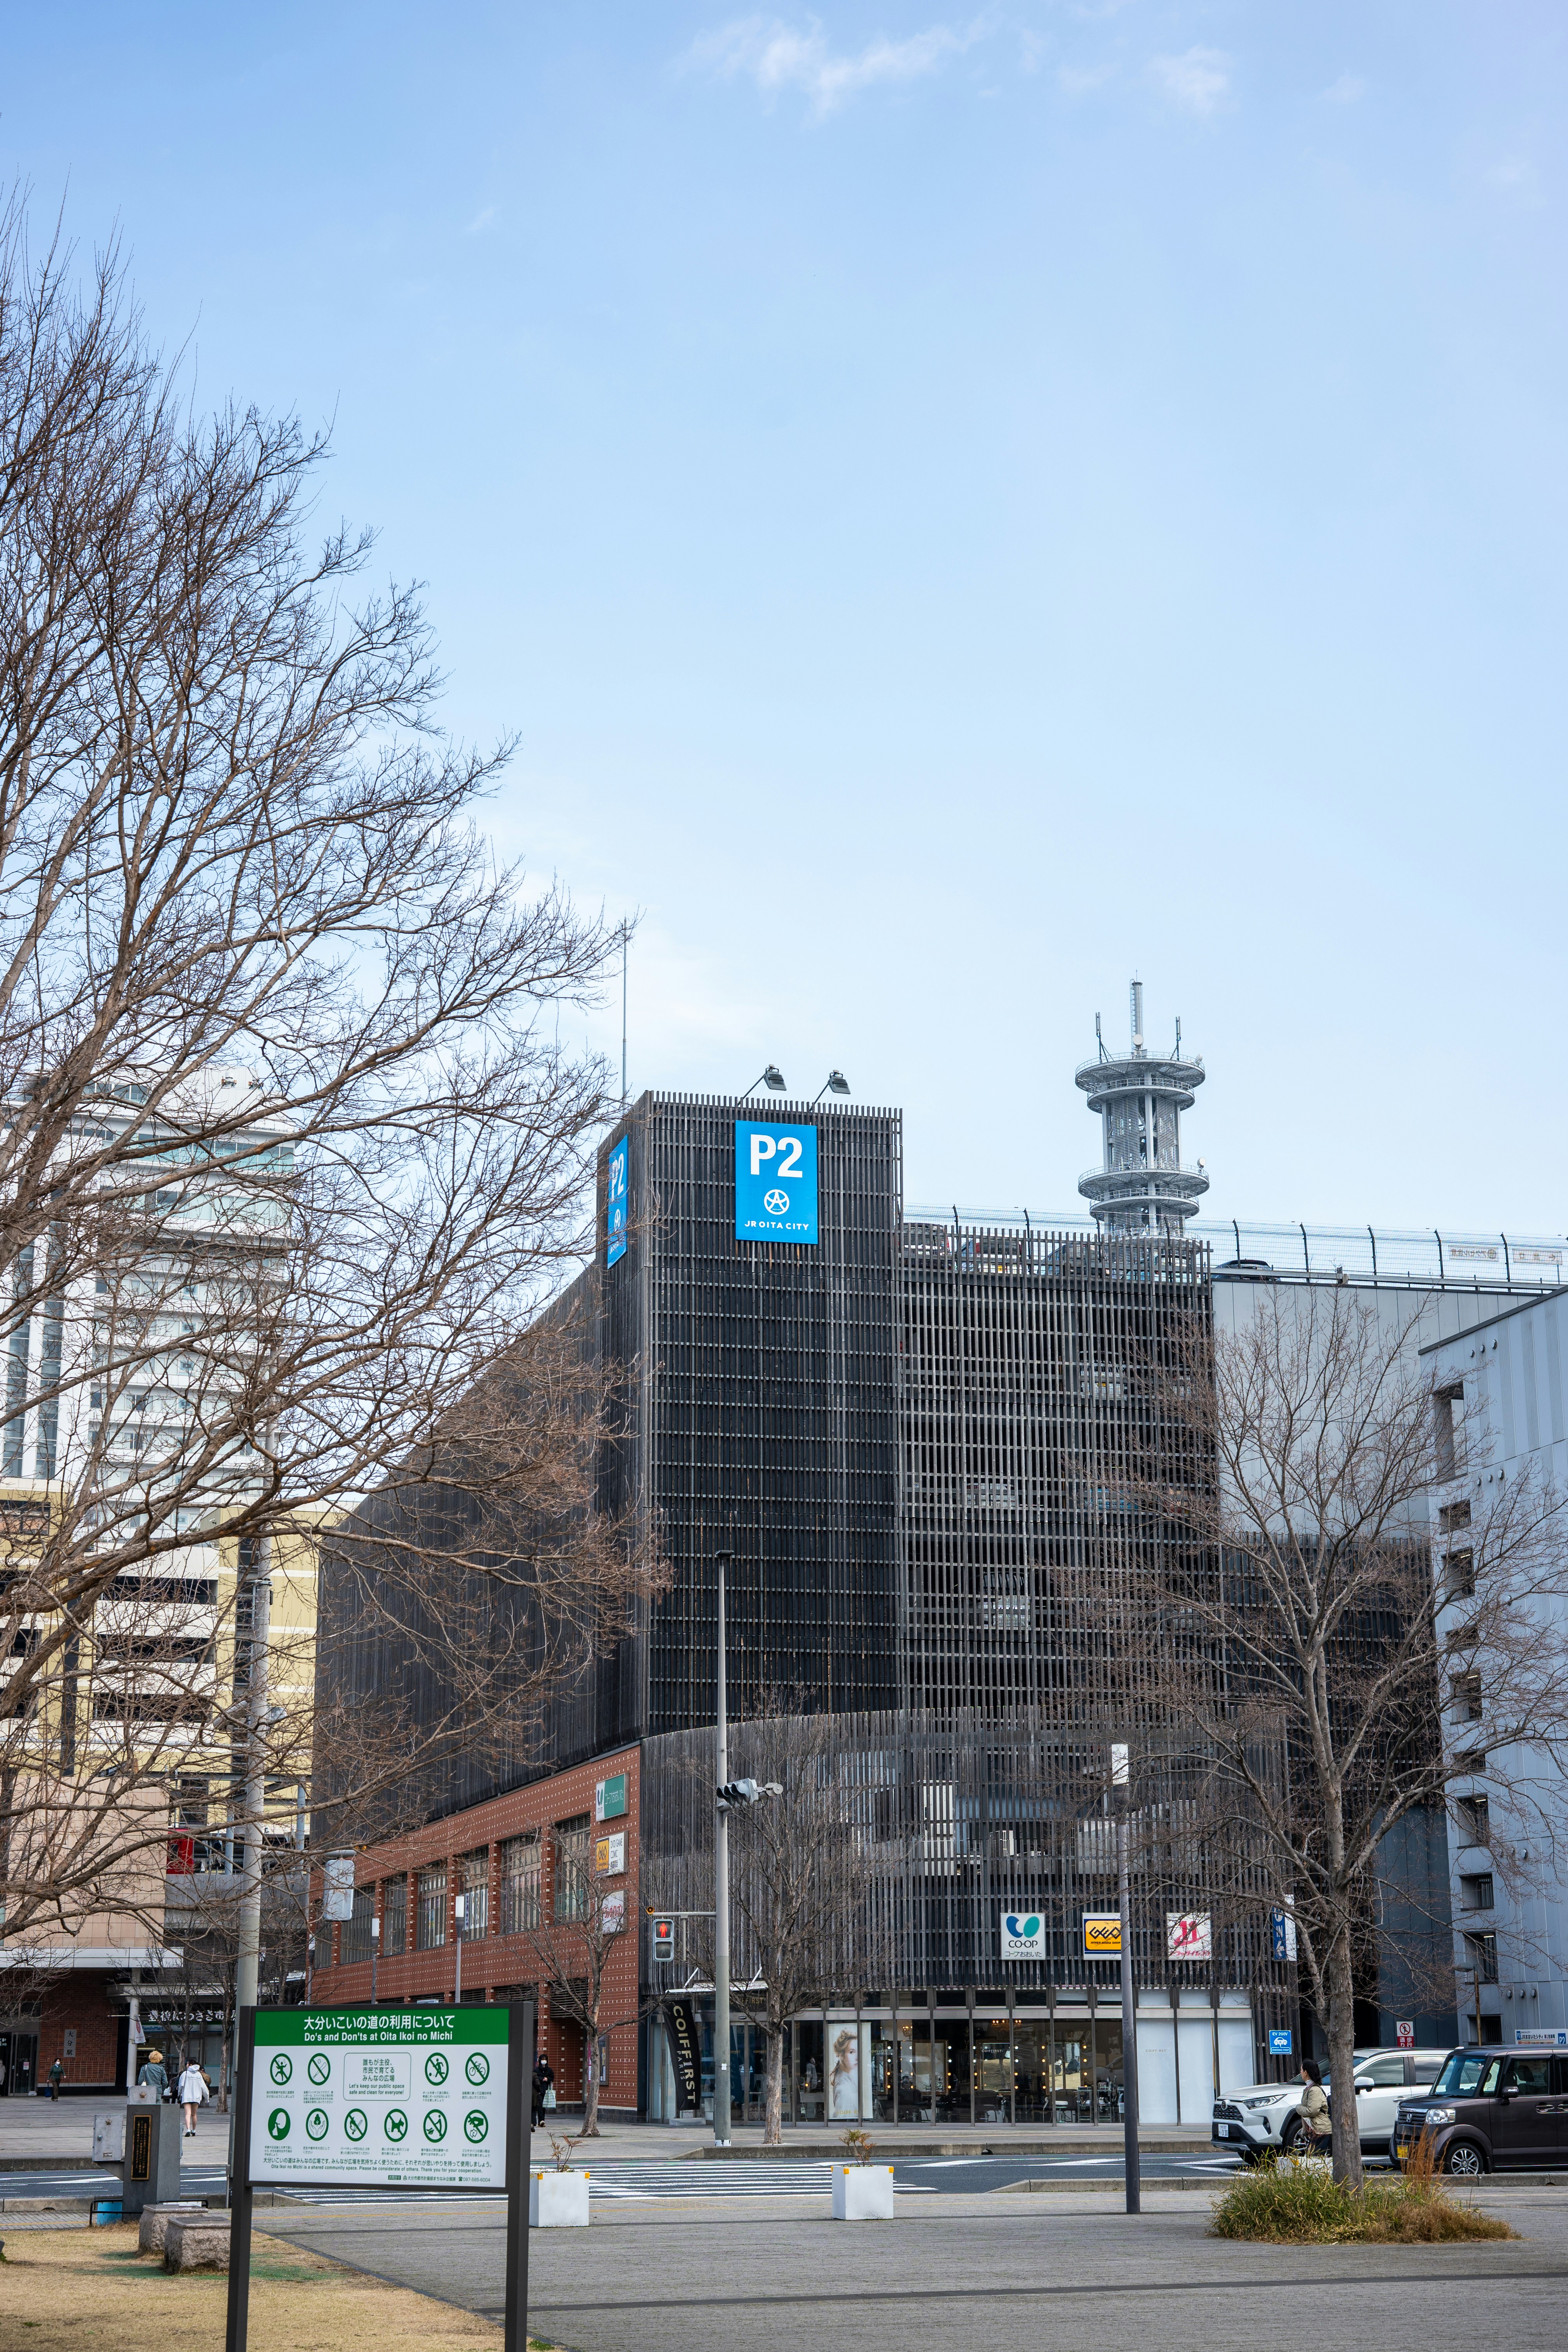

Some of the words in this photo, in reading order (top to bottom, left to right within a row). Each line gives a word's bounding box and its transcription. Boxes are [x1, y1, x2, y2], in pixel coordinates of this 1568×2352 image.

[751, 1134, 803, 1178] P2
[611, 1838, 623, 1849] DVD/GAME
[1276, 1925, 1283, 1937] IN
[304, 2015, 455, 2030] 大分いこいの道の利用について
[304, 2032, 322, 2041] Do's
[324, 2032, 339, 2041] and
[341, 2032, 368, 2041] Don'ts
[370, 2032, 378, 2040] at
[380, 2032, 397, 2040] Oita
[399, 2031, 415, 2040] Ikoi
[430, 2031, 453, 2040] Michi
[677, 2051, 685, 2080] PARIS
